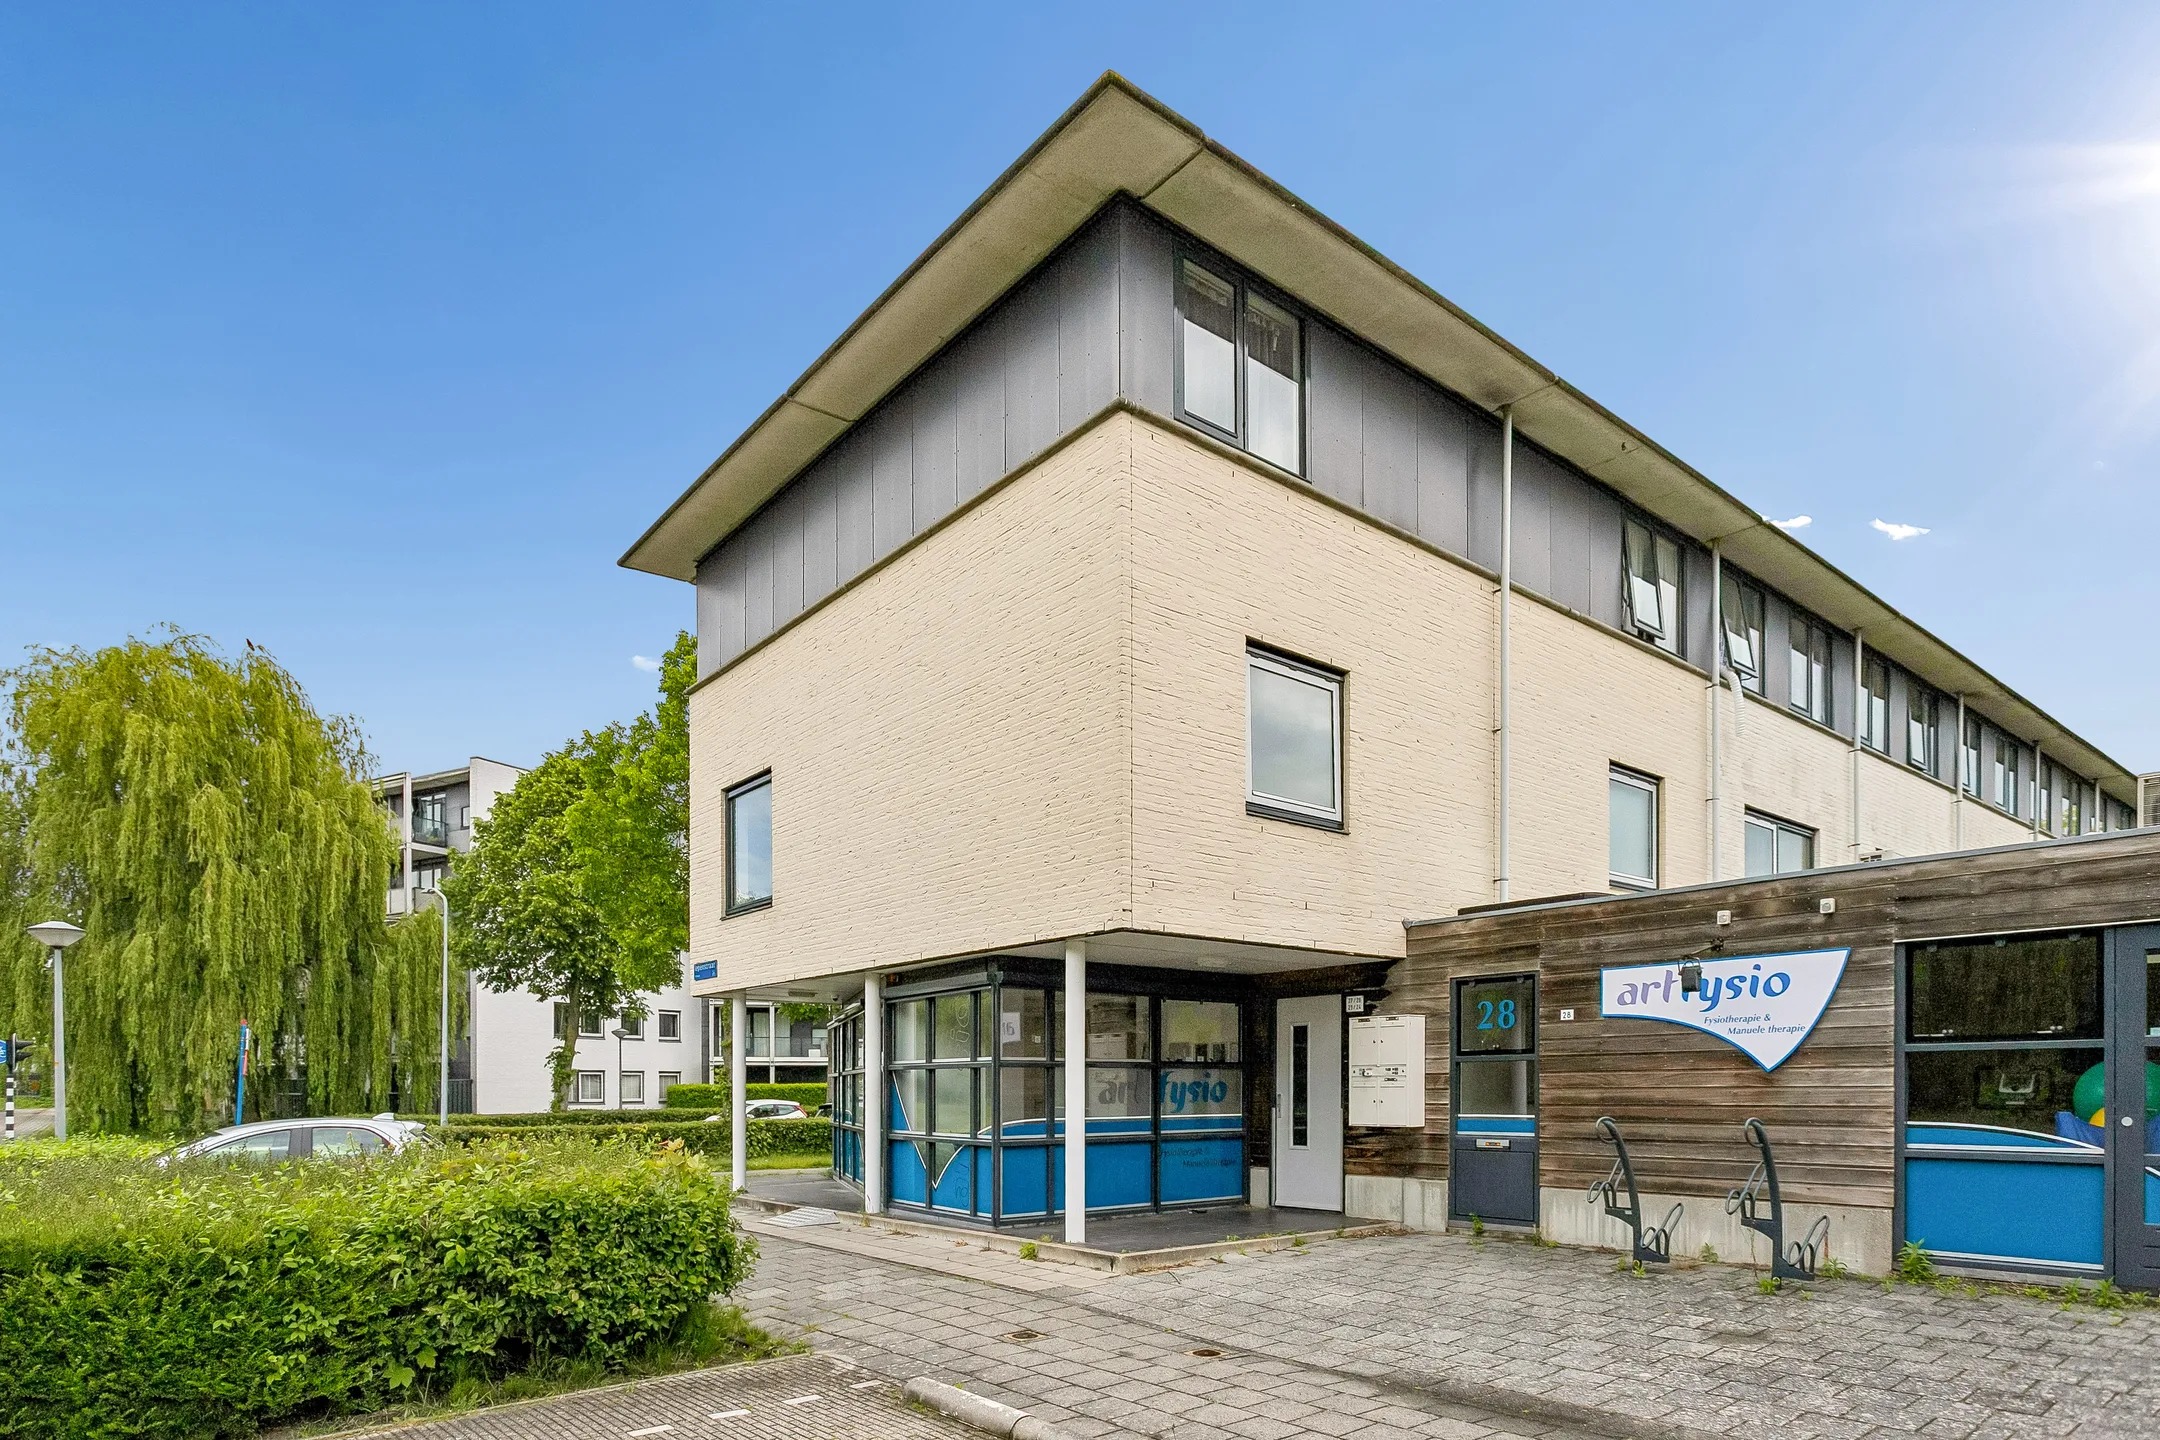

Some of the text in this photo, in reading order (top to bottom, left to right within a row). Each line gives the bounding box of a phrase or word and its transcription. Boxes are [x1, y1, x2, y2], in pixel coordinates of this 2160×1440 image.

[1617, 963, 1791, 1012] artysio
[1477, 1000, 1515, 1030] 28
[1563, 1011, 1571, 1019] 28
[1704, 1013, 1771, 1026] Fysiotherapie &
[1727, 1024, 1806, 1035] Manuele therapie
